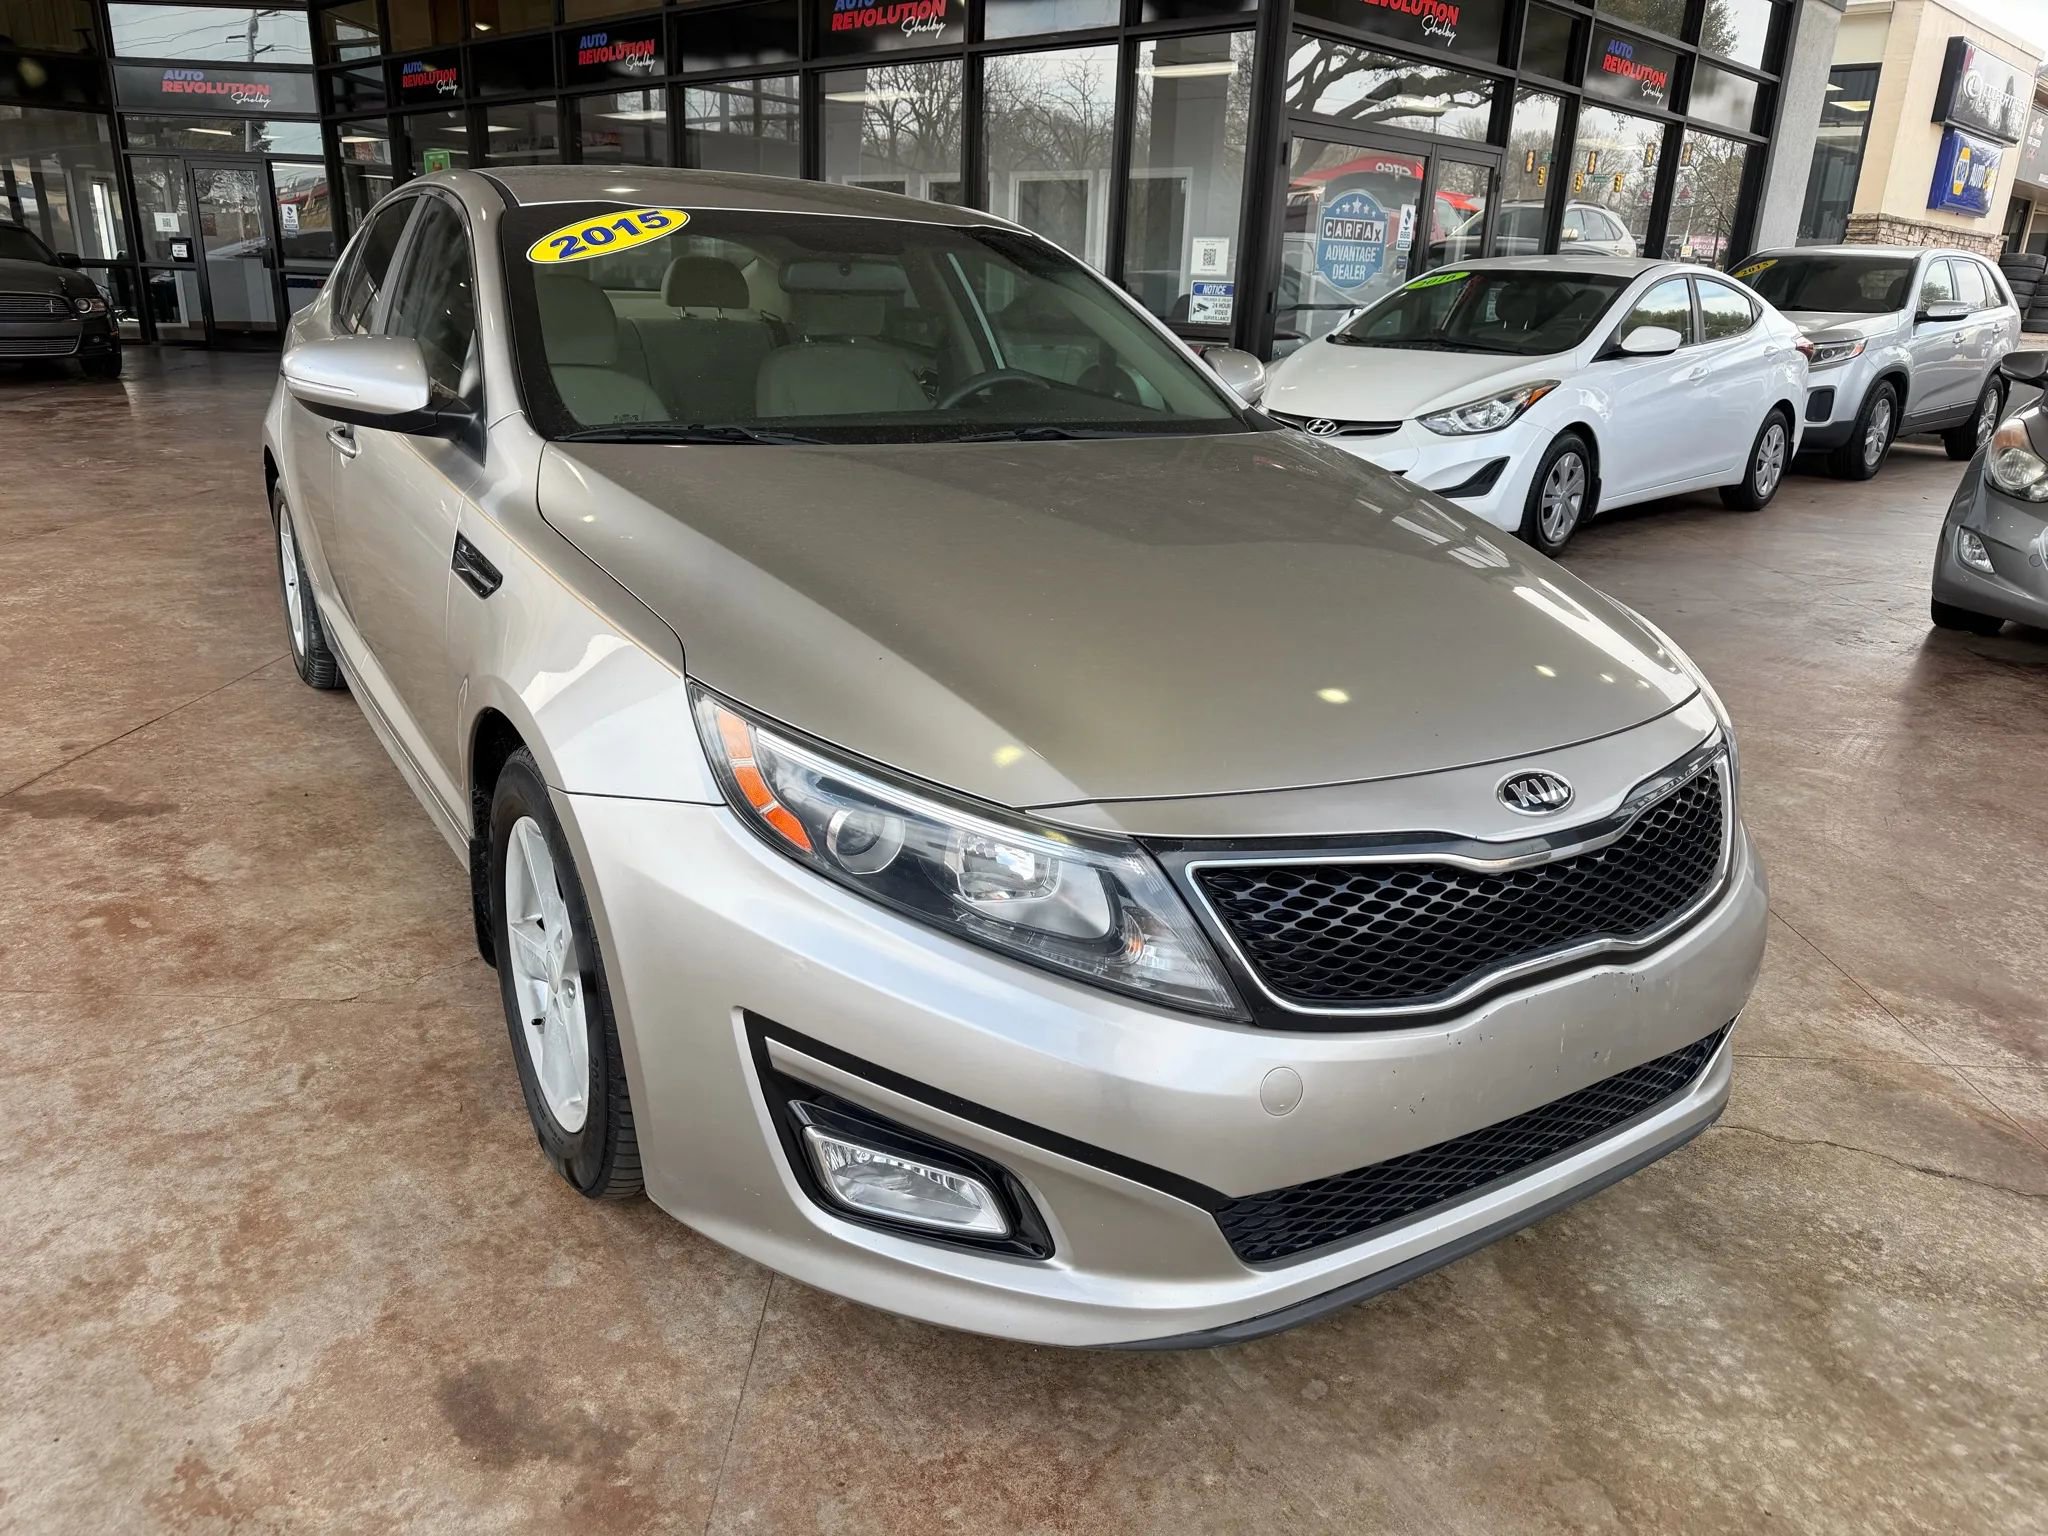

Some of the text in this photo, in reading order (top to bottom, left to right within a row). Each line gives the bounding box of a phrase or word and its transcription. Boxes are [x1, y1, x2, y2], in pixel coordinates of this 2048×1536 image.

[832, 0, 947, 31] REVOLUTION
[1362, 0, 1460, 26] OLUTION
[901, 12, 946, 39] Shelby
[1421, 14, 1457, 47] Shelby
[579, 32, 608, 49] AUTO
[1607, 39, 1634, 59] AUTO
[578, 39, 656, 65] REVOLUTION
[625, 51, 656, 73] Shelby
[163, 69, 204, 81] AUTO
[402, 61, 423, 75] AUTO
[402, 68, 457, 88] REVOLUTION
[1602, 53, 1668, 88] REVOLUTION
[161, 80, 272, 96] REVOLUTION
[1641, 79, 1664, 105] Shelby
[230, 91, 272, 108] Shelby
[549, 210, 672, 259] 2015
[1323, 219, 1382, 243] CARFAX
[1325, 244, 1377, 262] ADVANTAGE
[1332, 263, 1366, 280] DEALER
[1742, 262, 1769, 276] 2015
[1202, 284, 1227, 295] NOTICE
[1507, 776, 1569, 808] KIA
